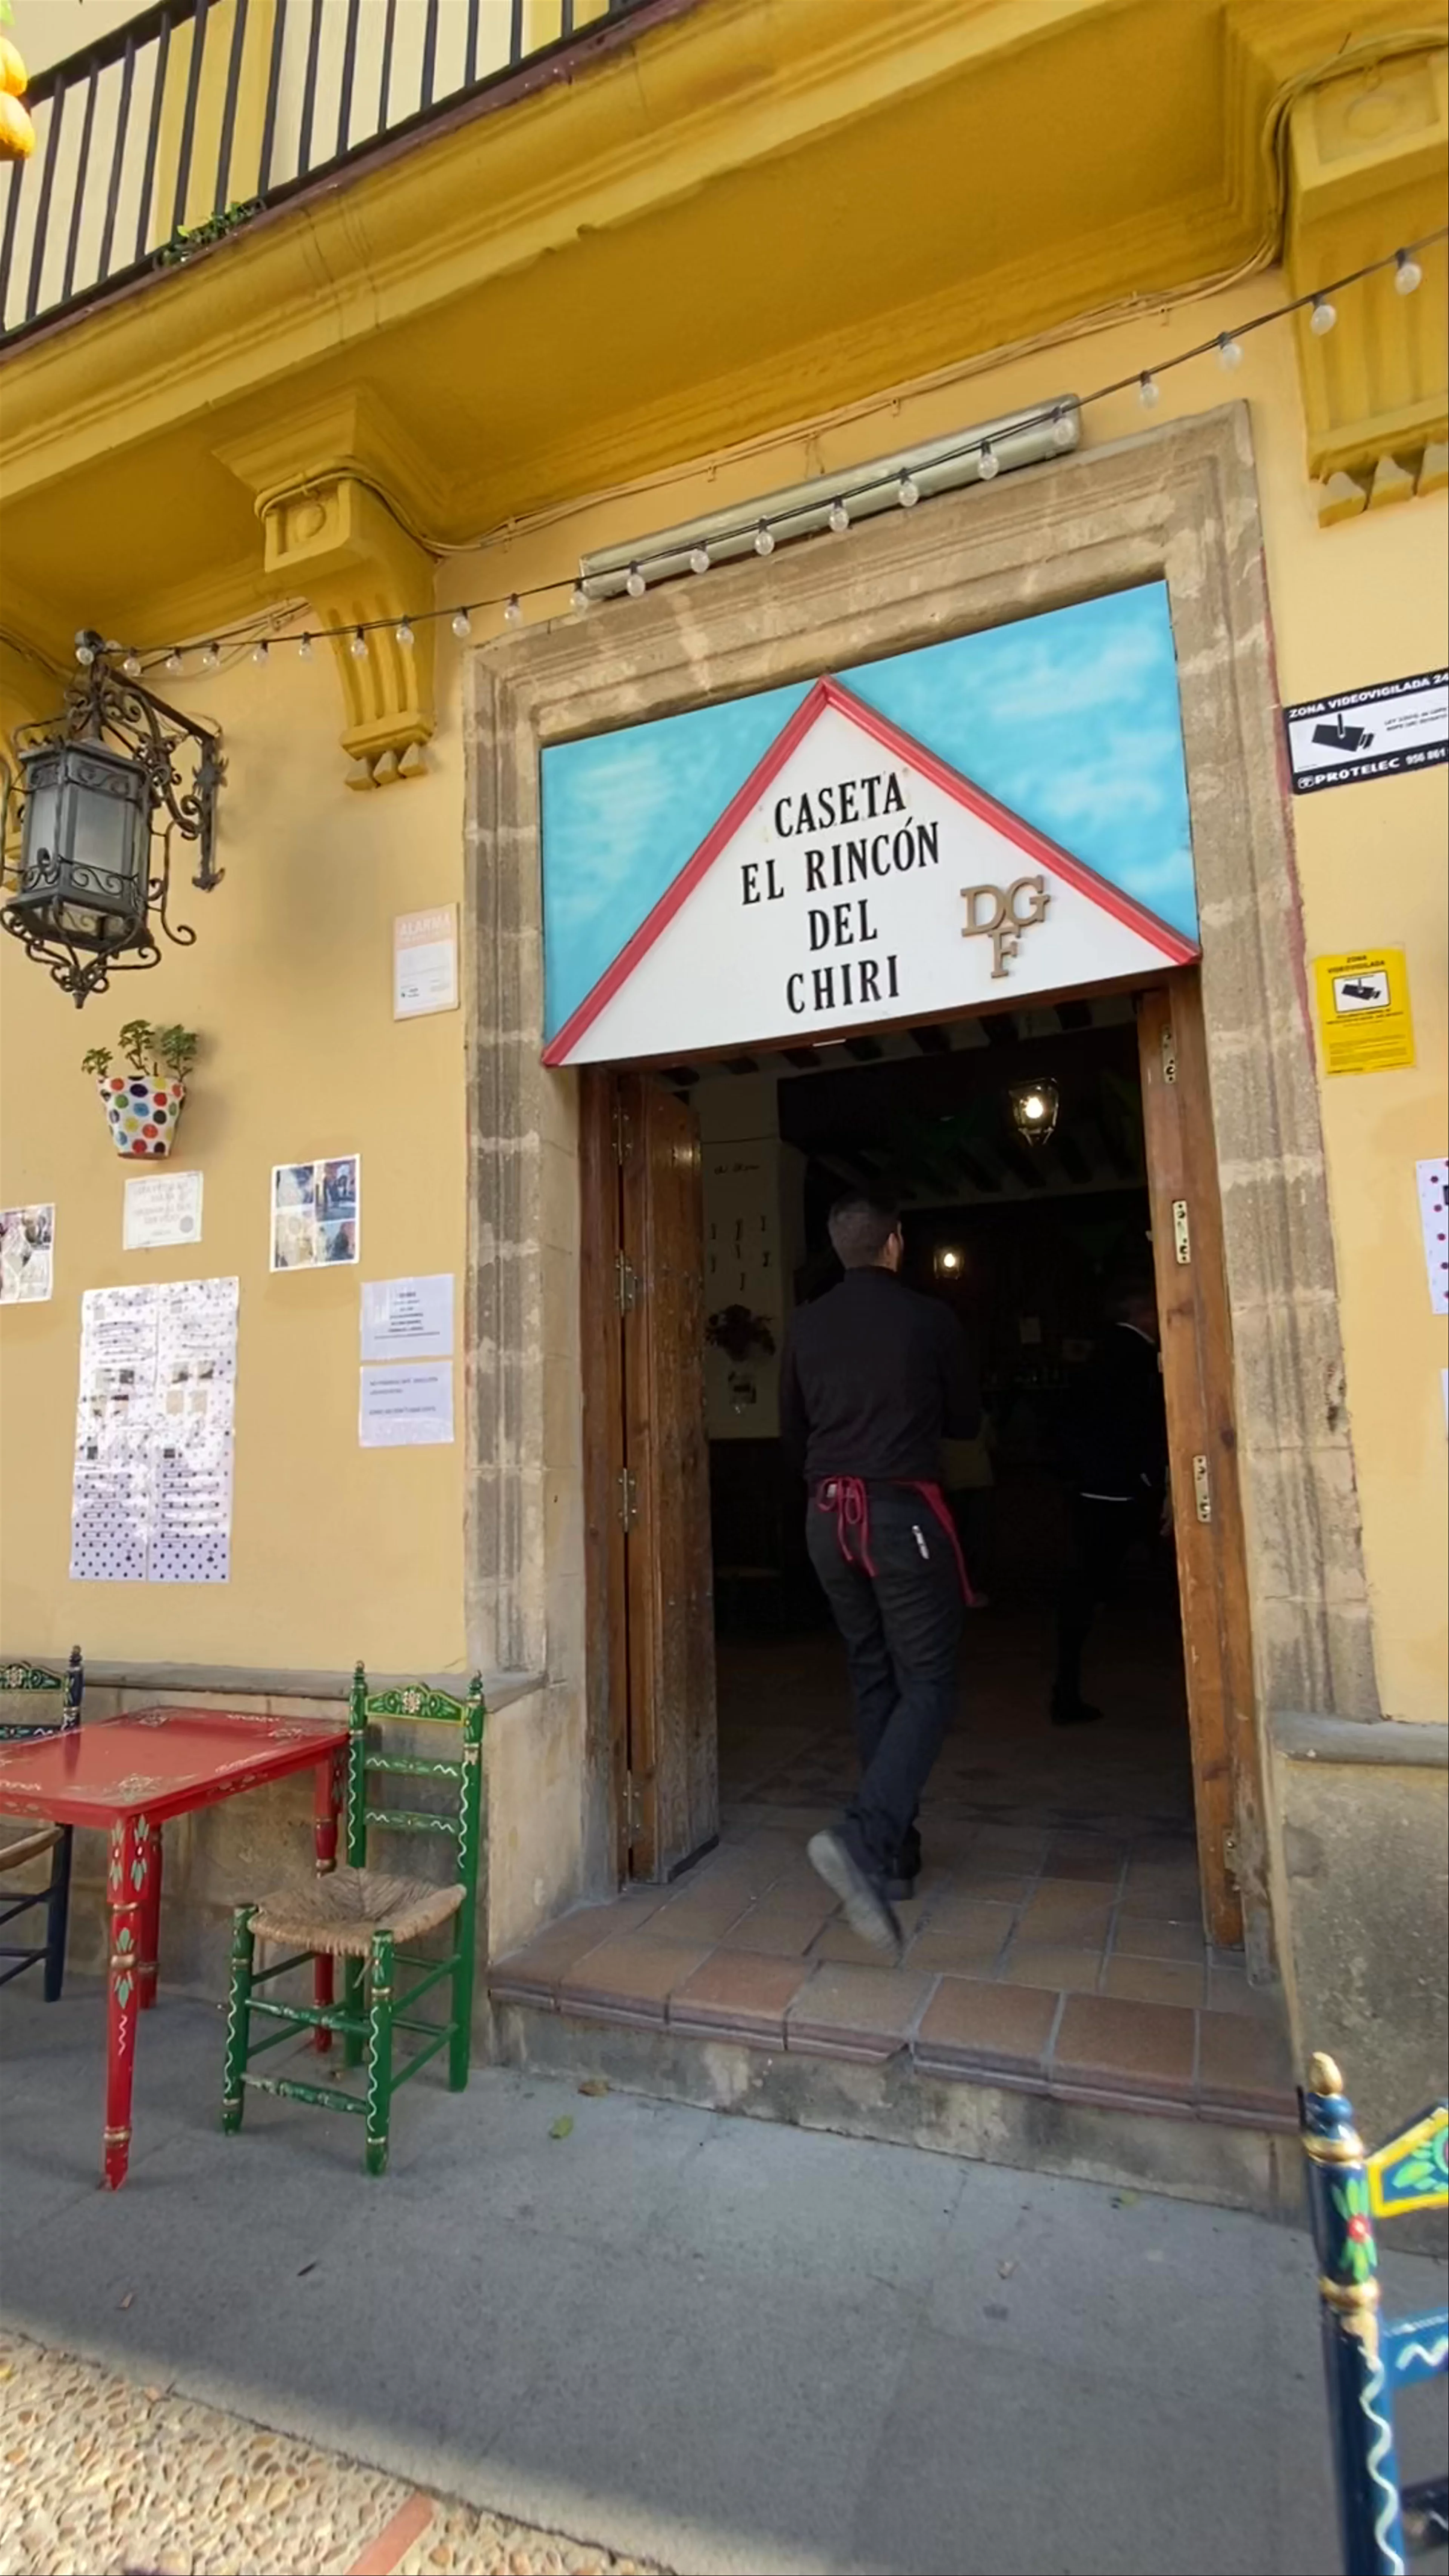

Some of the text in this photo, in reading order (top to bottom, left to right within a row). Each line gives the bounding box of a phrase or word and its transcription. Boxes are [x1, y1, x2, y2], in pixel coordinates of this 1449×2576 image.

[1288, 703, 1325, 718] ZONA
[1328, 677, 1430, 708] VIDEOVIGILADA
[1314, 757, 1401, 785] PROTELEC
[774, 771, 906, 837] CASETA
[741, 817, 940, 905] EL RINCÓN
[808, 899, 878, 951] DEL
[786, 955, 900, 1014] CHIRI
